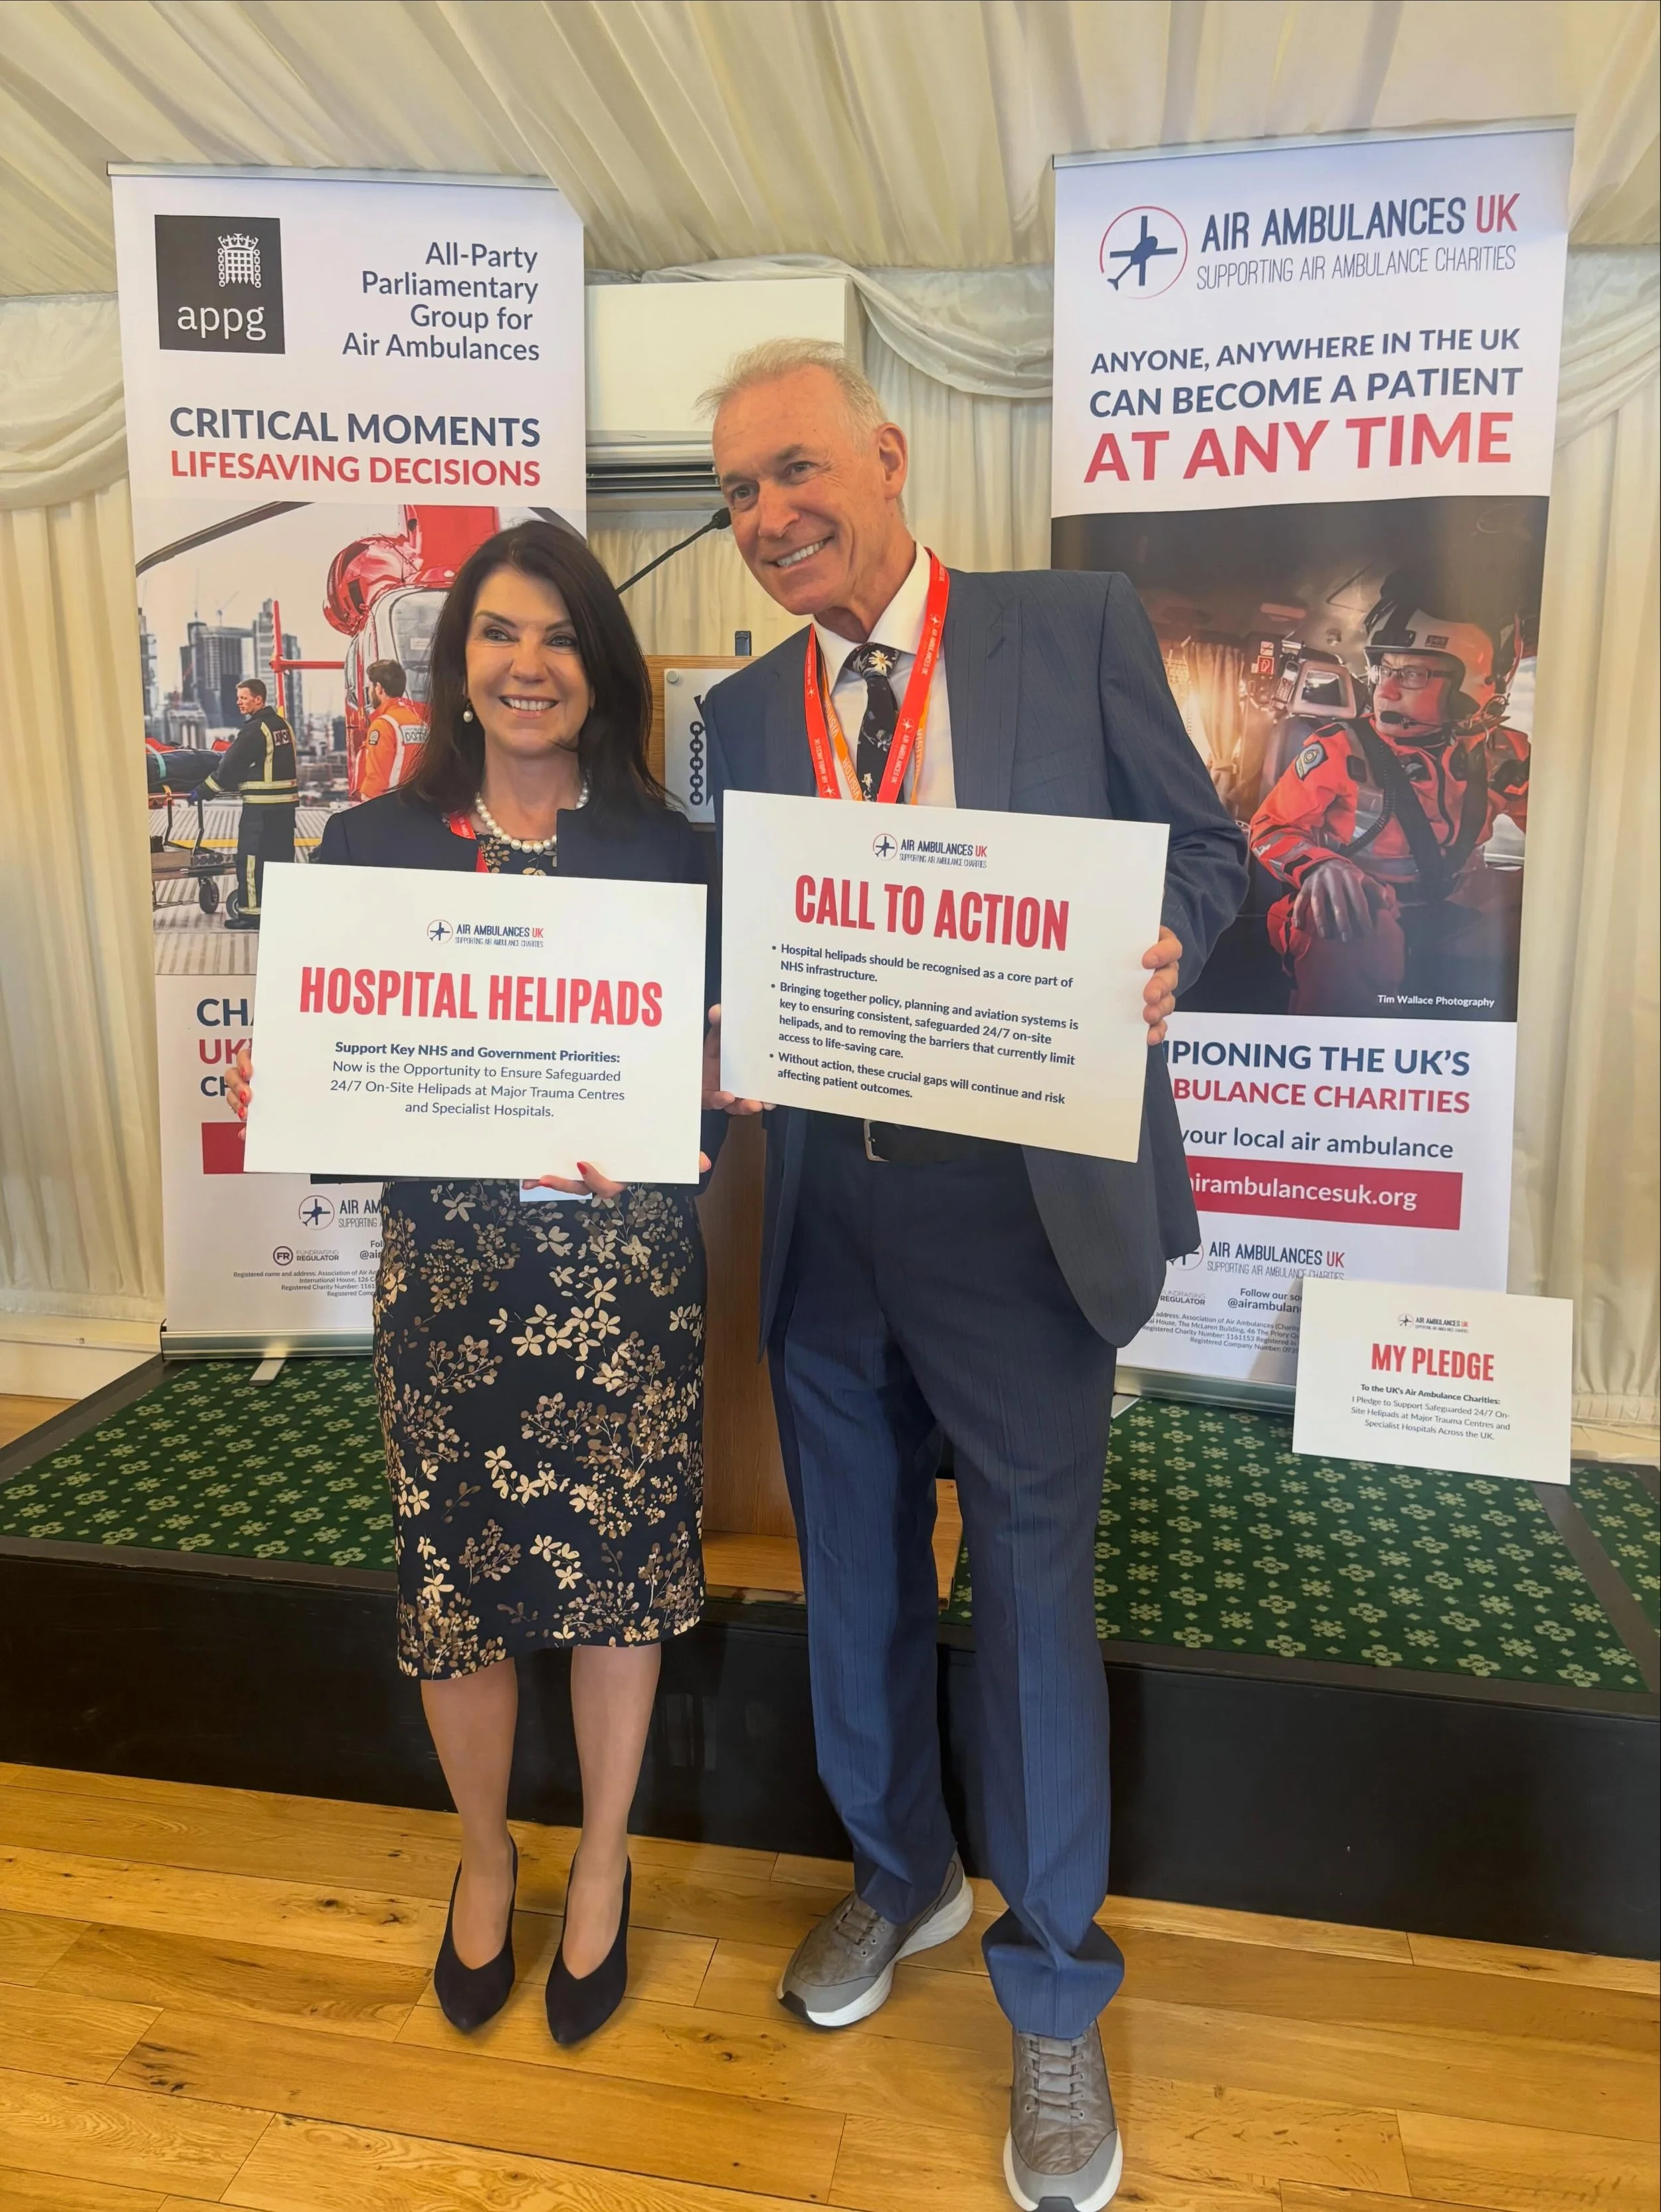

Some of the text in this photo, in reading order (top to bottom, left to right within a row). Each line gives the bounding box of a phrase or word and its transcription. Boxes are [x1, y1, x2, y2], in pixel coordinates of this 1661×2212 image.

[1201, 193, 1520, 252] AIR AMBULANCES UK
[425, 242, 538, 273] All-Party
[1197, 244, 1516, 290] SUPPORTING AIR AMBULANCE CHARITIES
[363, 270, 538, 304] Parliamentary
[177, 306, 266, 341] appg
[411, 304, 533, 333] Group for
[342, 332, 539, 361] Air Ambulances
[1090, 328, 1520, 374] ANYONE, ANYWHERE IN THE UK
[1090, 367, 1523, 418] CAN BECOME A PATIENT
[170, 407, 540, 447] CRITICAL MOMENTS
[1084, 412, 1513, 483] AT ANY TIME
[171, 450, 540, 486] LIFESAVING DECISIONS
[901, 839, 987, 857] AIR AMBULANCES UK
[795, 875, 1069, 951] CALL TO ACTION
[456, 924, 543, 938] AIR AMBULANCES UK
[781, 943, 822, 958] Hospital
[825, 949, 866, 963] helipads
[869, 955, 904, 968] should
[907, 959, 920, 970] be
[922, 963, 981, 976] recognised
[1007, 973, 1032, 982] core
[1034, 976, 1058, 986] part
[1060, 978, 1073, 988] of
[781, 961, 877, 982] NHS infrastructure.
[300, 967, 478, 1019] HOSPITAL
[489, 975, 662, 1027] HELIPADS
[780, 982, 1078, 1030] Bringing together policy, planning and aviation systems is
[1377, 994, 1495, 1008] Tim Wallace Photography
[780, 998, 1052, 1044] key to ensuring consistent, safeguarded 24/7 on-site
[335, 1042, 620, 1063] Support Key NHS and Government Priorities:
[779, 1014, 1075, 1065] helipads, and to removing the barriers that currently limit
[333, 1061, 621, 1082] Now is the Opportunity to Ensure Safeguarded
[1319, 1046, 1385, 1073] THE
[1395, 1049, 1470, 1076] UK’S
[330, 1080, 625, 1100] 24/7 On-Site Helipads at Major Trauma Centres
[1314, 1085, 1470, 1113] CHARITIES
[405, 1102, 554, 1118] and Specialist Hospitals.
[1234, 1127, 1284, 1149] local
[1292, 1132, 1321, 1151] air
[1327, 1135, 1453, 1158] ambulance
[340, 1200, 359, 1214] AIR
[1209, 1242, 1345, 1268] AIR AMBULANCES UK
[1160, 1295, 1206, 1305] REGULATOR
[1240, 1288, 1270, 1298] Follow
[1371, 1343, 1494, 1382] MY PLEDGE
[1357, 1396, 1382, 1406] Pledge
[1393, 1400, 1422, 1410] Support
[1425, 1404, 1472, 1415] Safeguarded
[1474, 1408, 1493, 1417] 24/7
[1418, 1390, 1461, 1400] Ambulance
[1463, 1394, 1500, 1404] Charities:
[1365, 1419, 1399, 1429] Specialist
[1402, 1423, 1436, 1433] Hospitals
[1438, 1428, 1464, 1436] Across
[1367, 1408, 1399, 1420] Helipads
[1411, 1413, 1432, 1422] Major
[1434, 1416, 1462, 1425] Trauma
[1464, 1419, 1494, 1428] Centres
